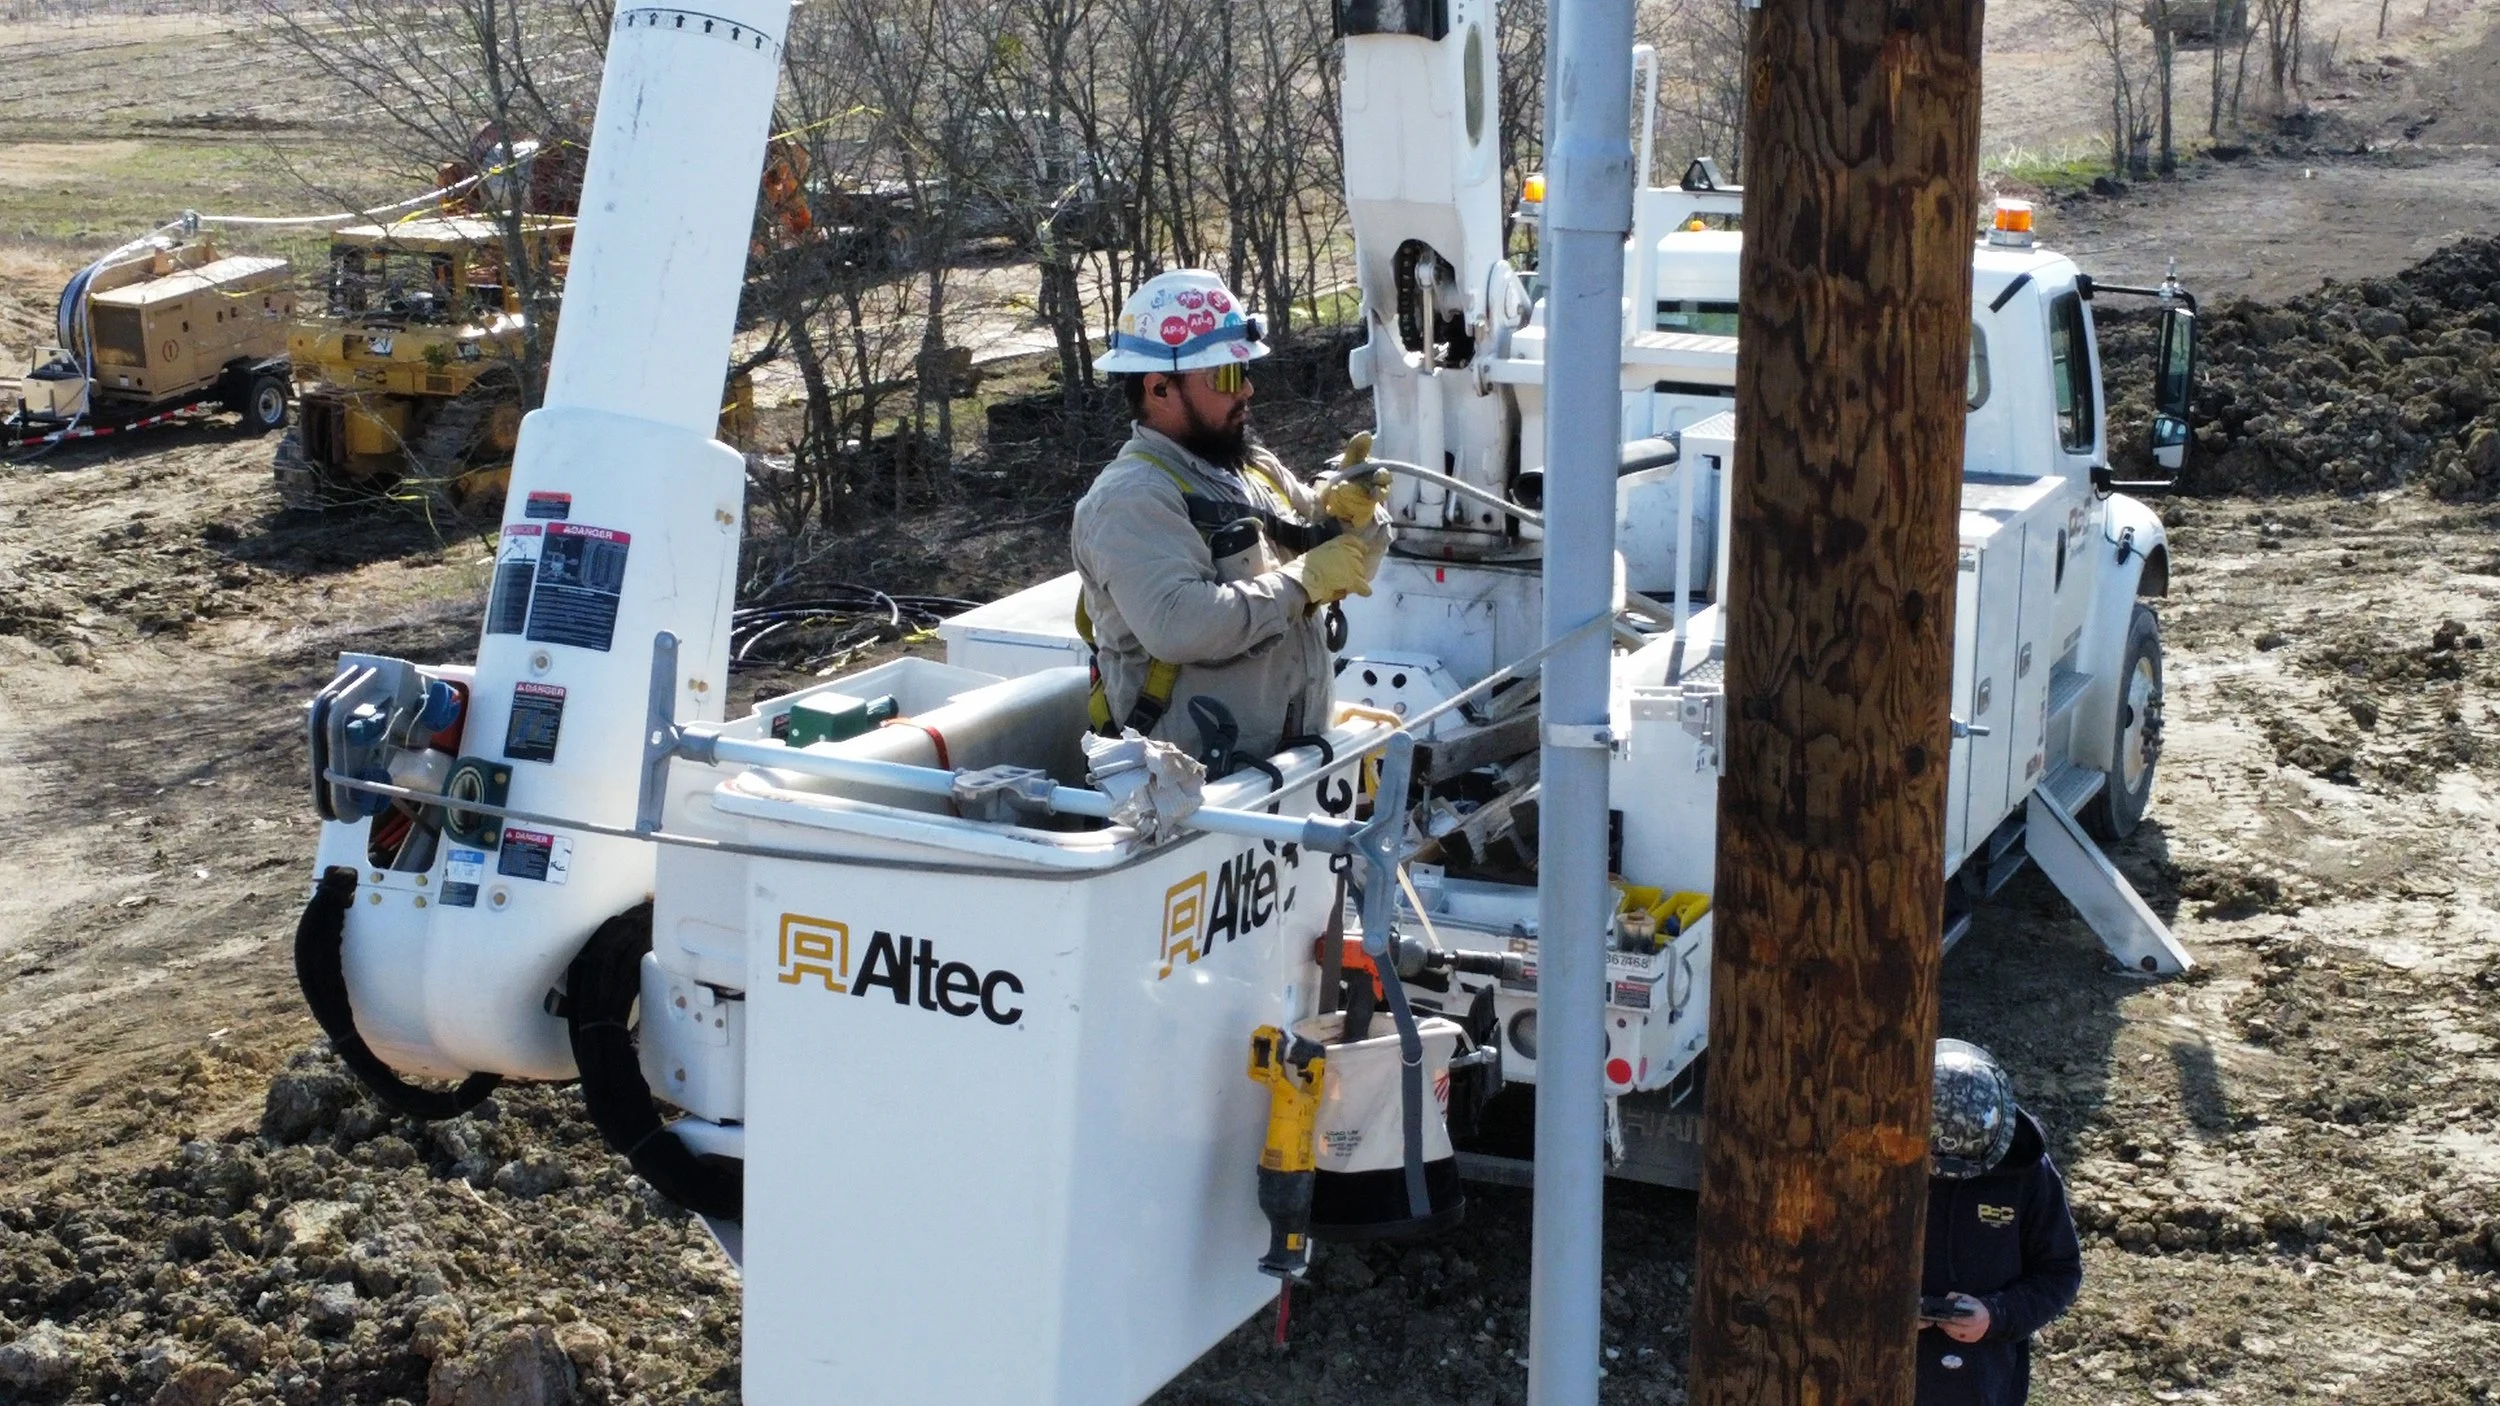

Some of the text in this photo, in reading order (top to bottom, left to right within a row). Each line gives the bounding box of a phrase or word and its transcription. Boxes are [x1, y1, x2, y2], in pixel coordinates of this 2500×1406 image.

[569, 526, 613, 540] DANGER
[525, 684, 564, 697] DANGER
[515, 831, 548, 844] DANGER
[851, 930, 1024, 1026] Altec
